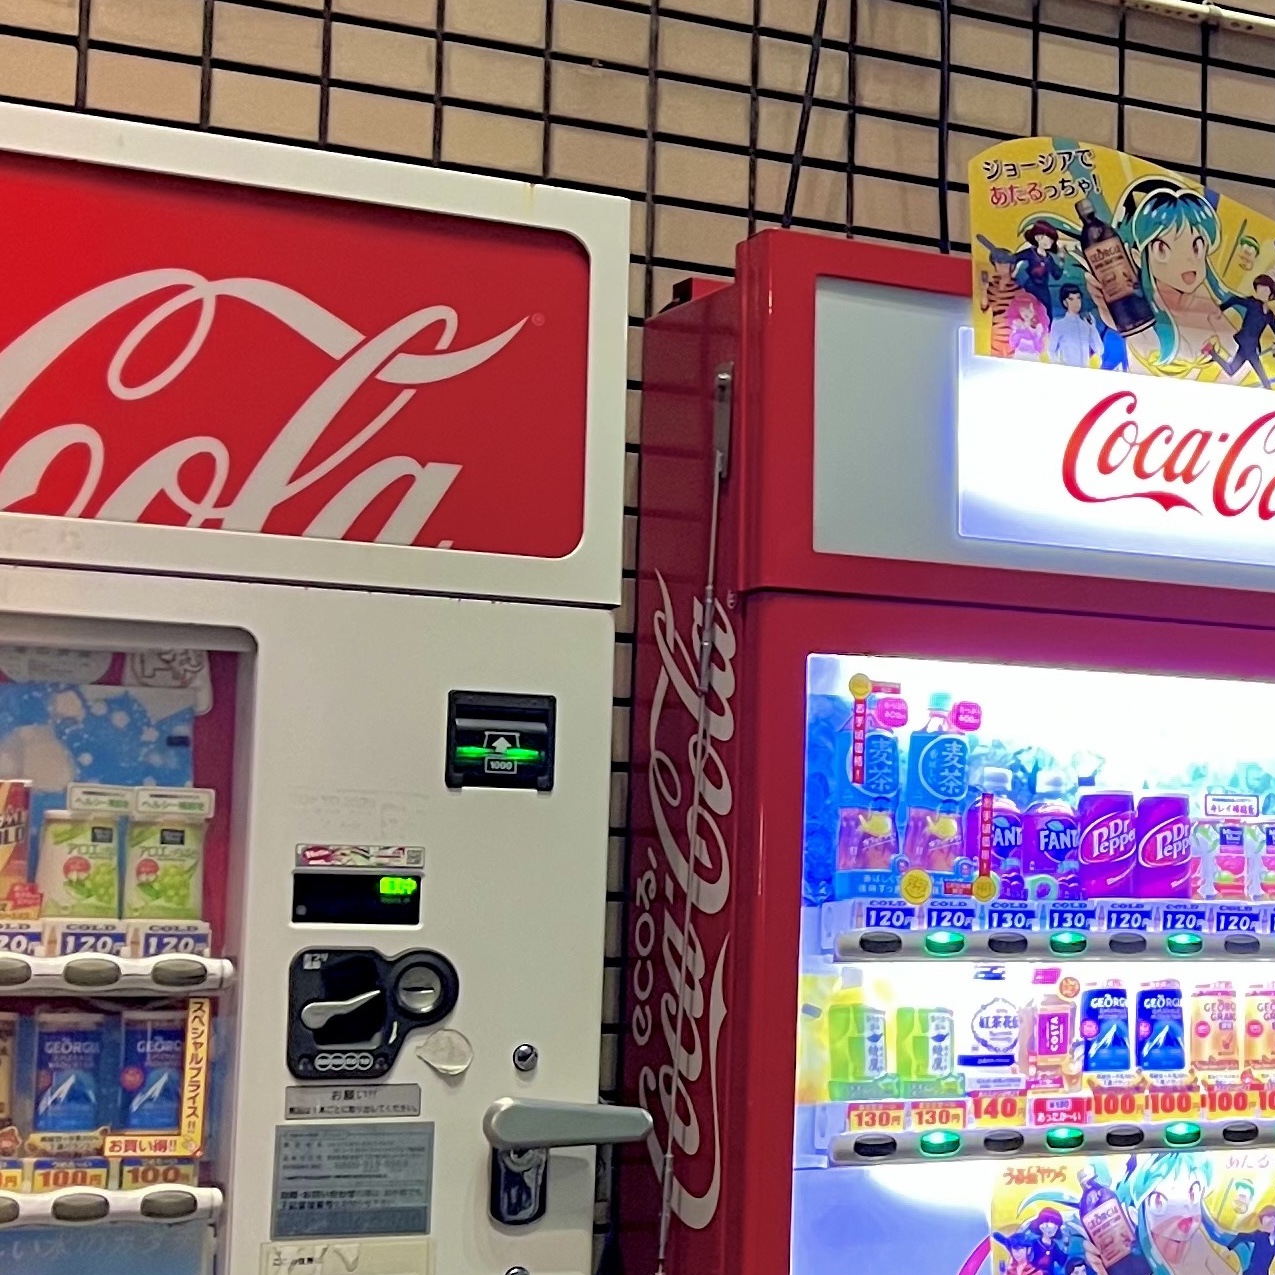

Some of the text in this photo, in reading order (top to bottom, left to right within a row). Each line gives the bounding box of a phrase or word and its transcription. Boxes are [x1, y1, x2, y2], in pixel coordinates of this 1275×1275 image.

[983, 149, 1094, 180] ジョージアで
[869, 738, 893, 791] 麦茶
[941, 741, 964, 794] 麦茶
[1110, 819, 1130, 837] Dr
[185, 1001, 206, 1134] スペシャルプライス!!
[854, 1111, 901, 1127] 130円
[915, 1110, 960, 1125] 130円
[39, 1171, 102, 1187] 100円
